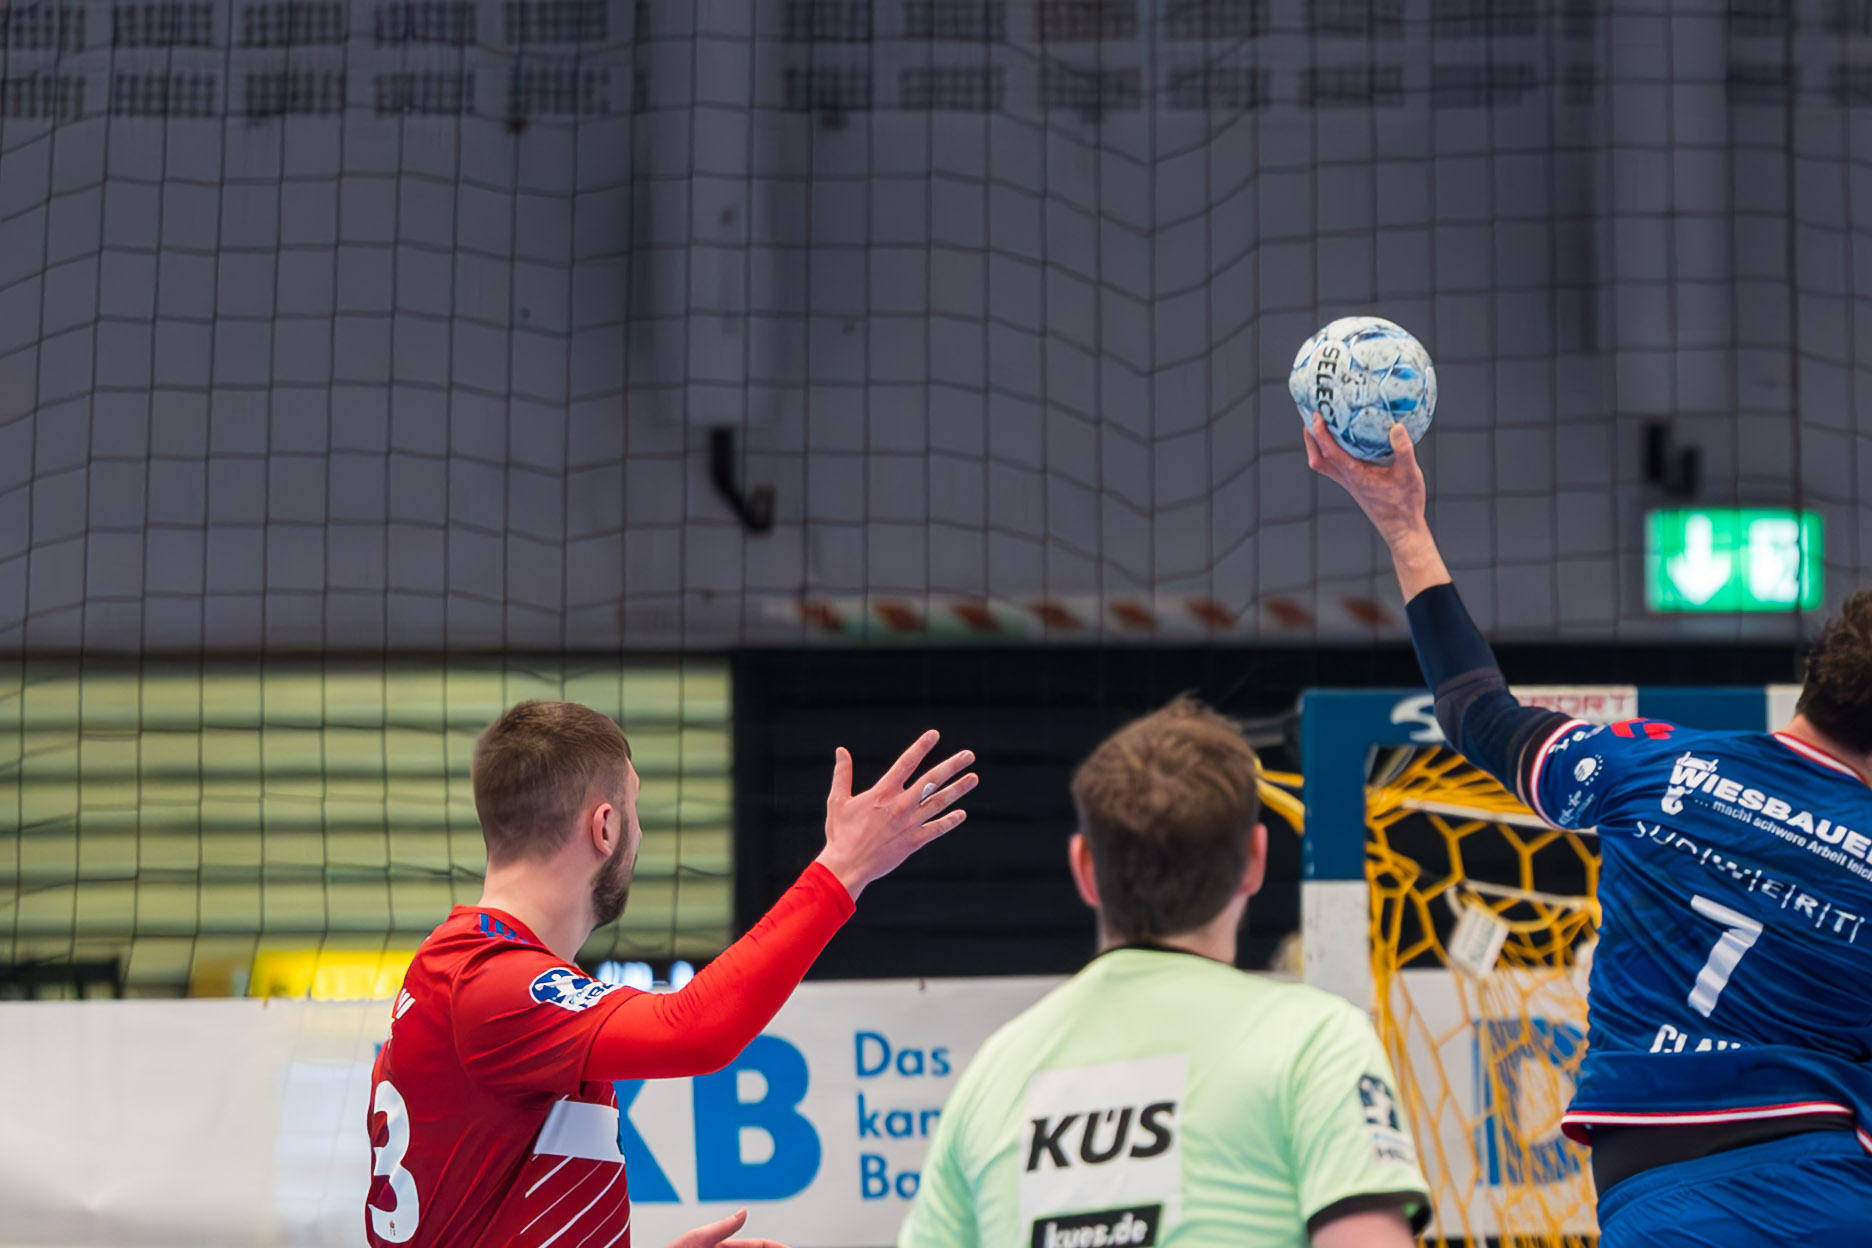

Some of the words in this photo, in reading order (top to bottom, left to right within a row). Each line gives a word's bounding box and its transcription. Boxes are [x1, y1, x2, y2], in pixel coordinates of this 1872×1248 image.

[1687, 894, 1764, 1018] 7
[854, 1030, 952, 1078] Das
[1026, 1101, 1177, 1173] KÜS
